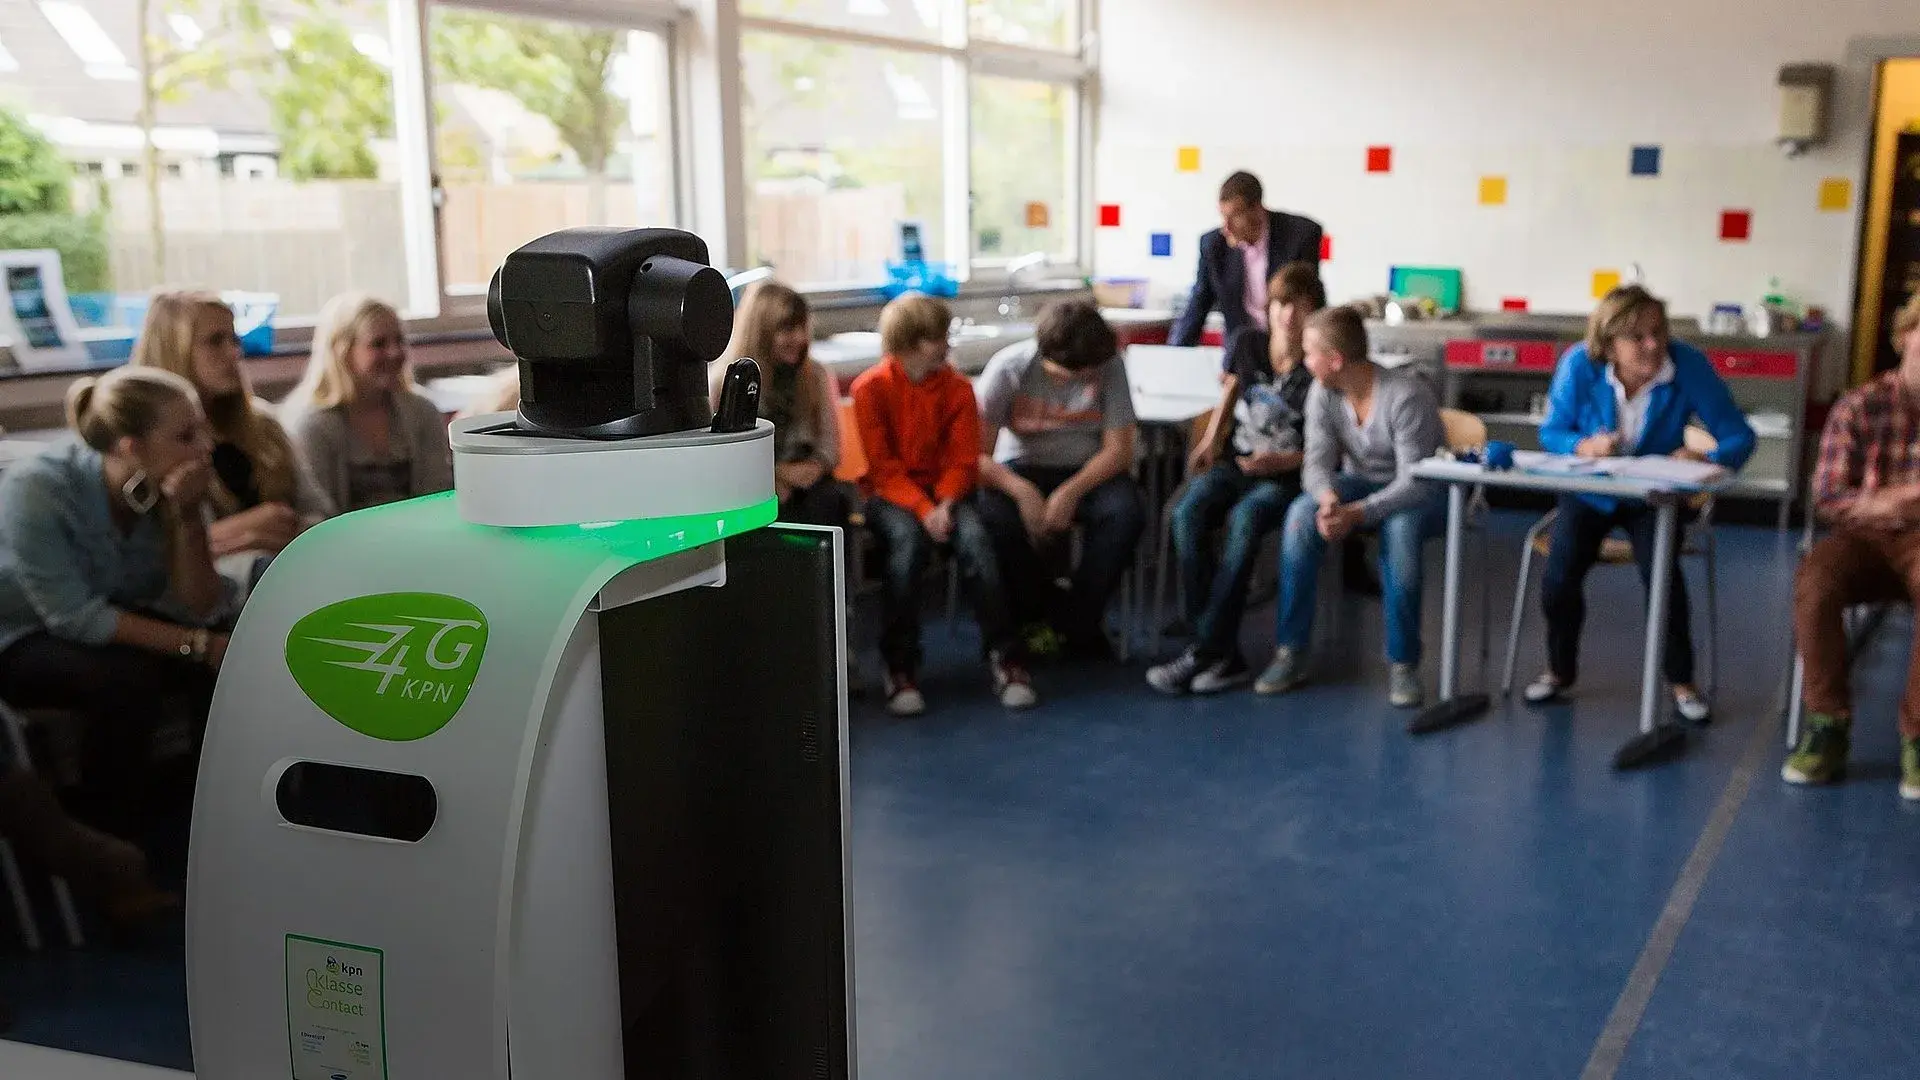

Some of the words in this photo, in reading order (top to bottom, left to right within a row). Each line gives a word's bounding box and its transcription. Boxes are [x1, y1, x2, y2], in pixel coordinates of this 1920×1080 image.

[301, 614, 482, 695] 4G
[401, 678, 454, 704] KPN
[306, 968, 363, 996] Klasse
[341, 962, 363, 977] kpn
[307, 989, 364, 1017] Contact
